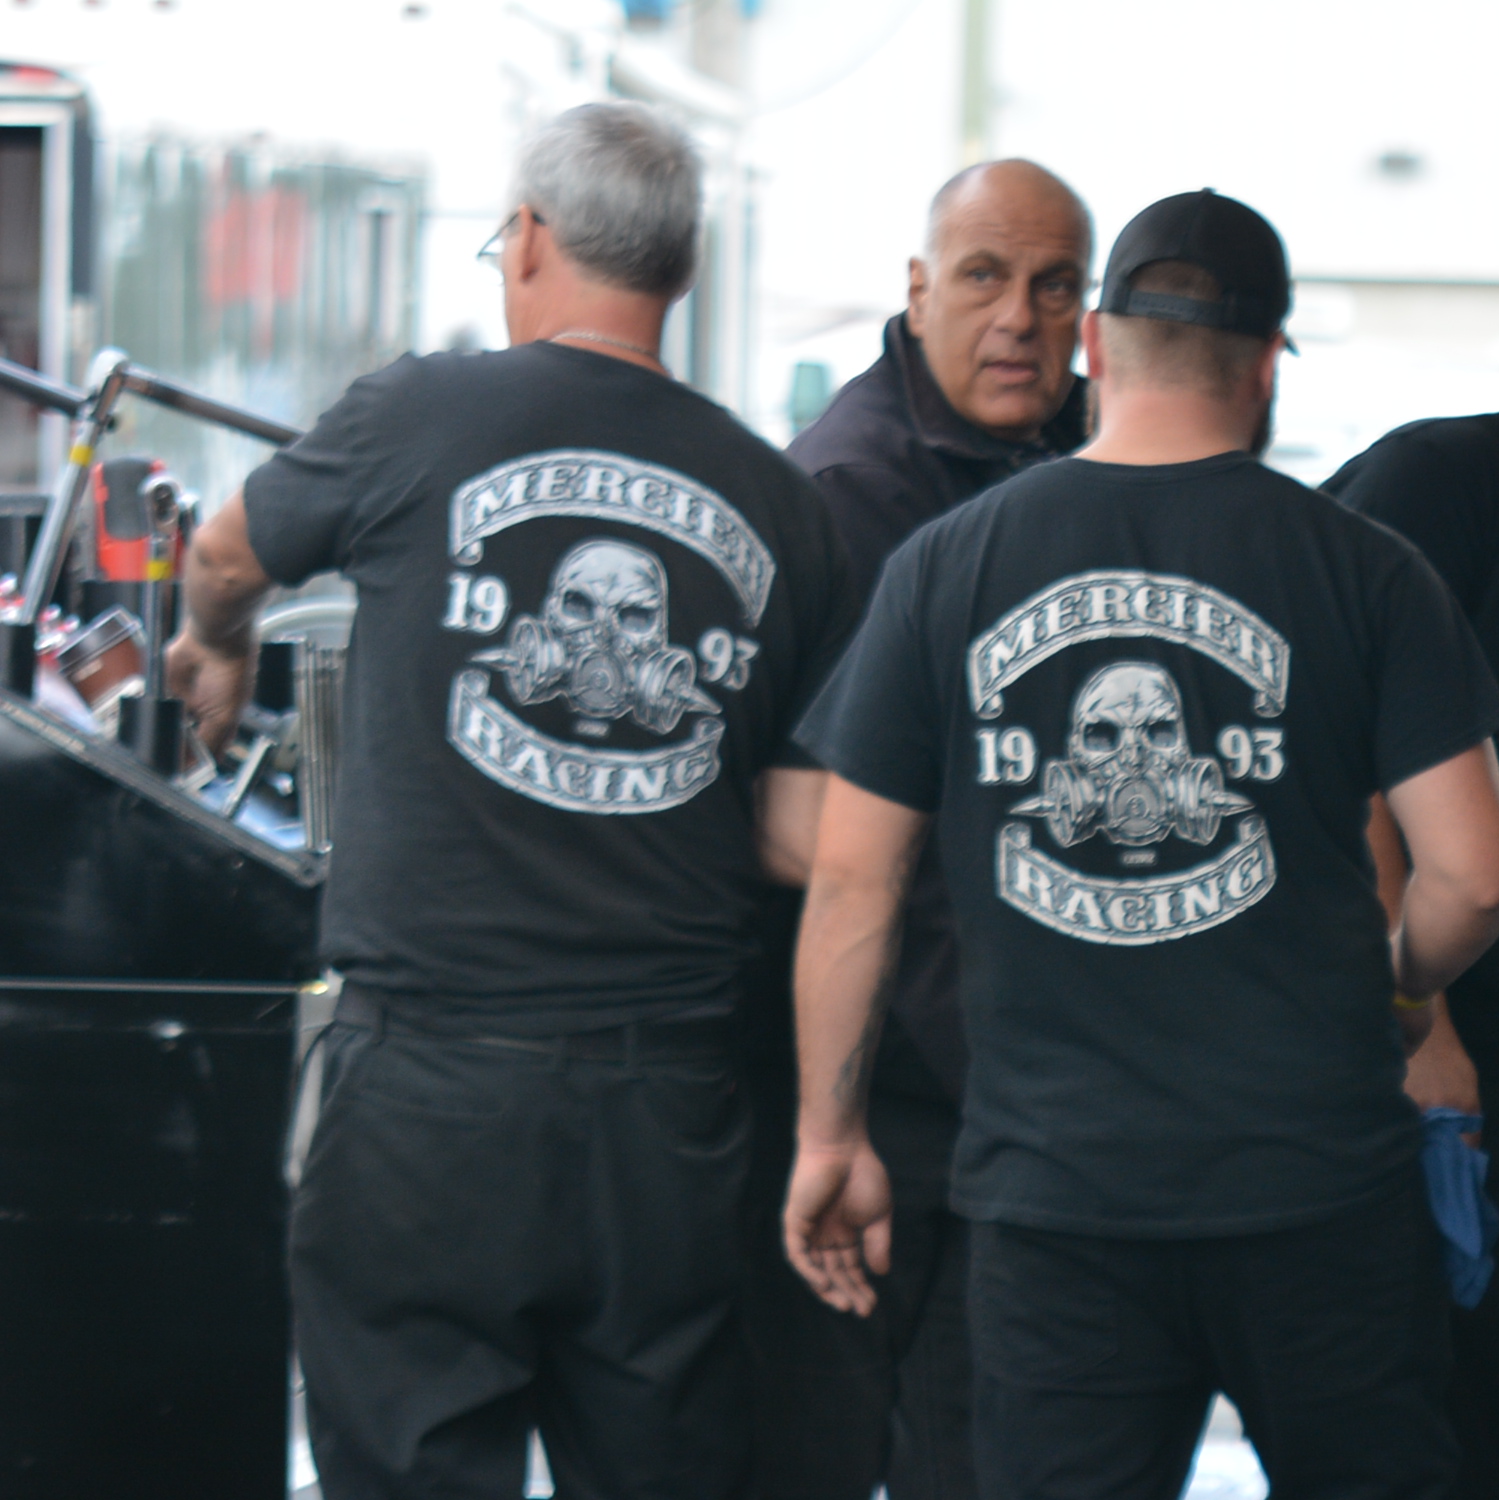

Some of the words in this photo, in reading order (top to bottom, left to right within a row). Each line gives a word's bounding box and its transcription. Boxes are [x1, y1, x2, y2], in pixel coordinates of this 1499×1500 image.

[466, 463, 765, 592] MERCIER
[443, 573, 508, 633] 19
[699, 627, 760, 691] 93
[988, 583, 1277, 682] MERCIER
[464, 706, 710, 802] RACING
[976, 726, 1037, 784] 19
[1217, 725, 1285, 781] 93
[1013, 850, 1265, 933] RACING
